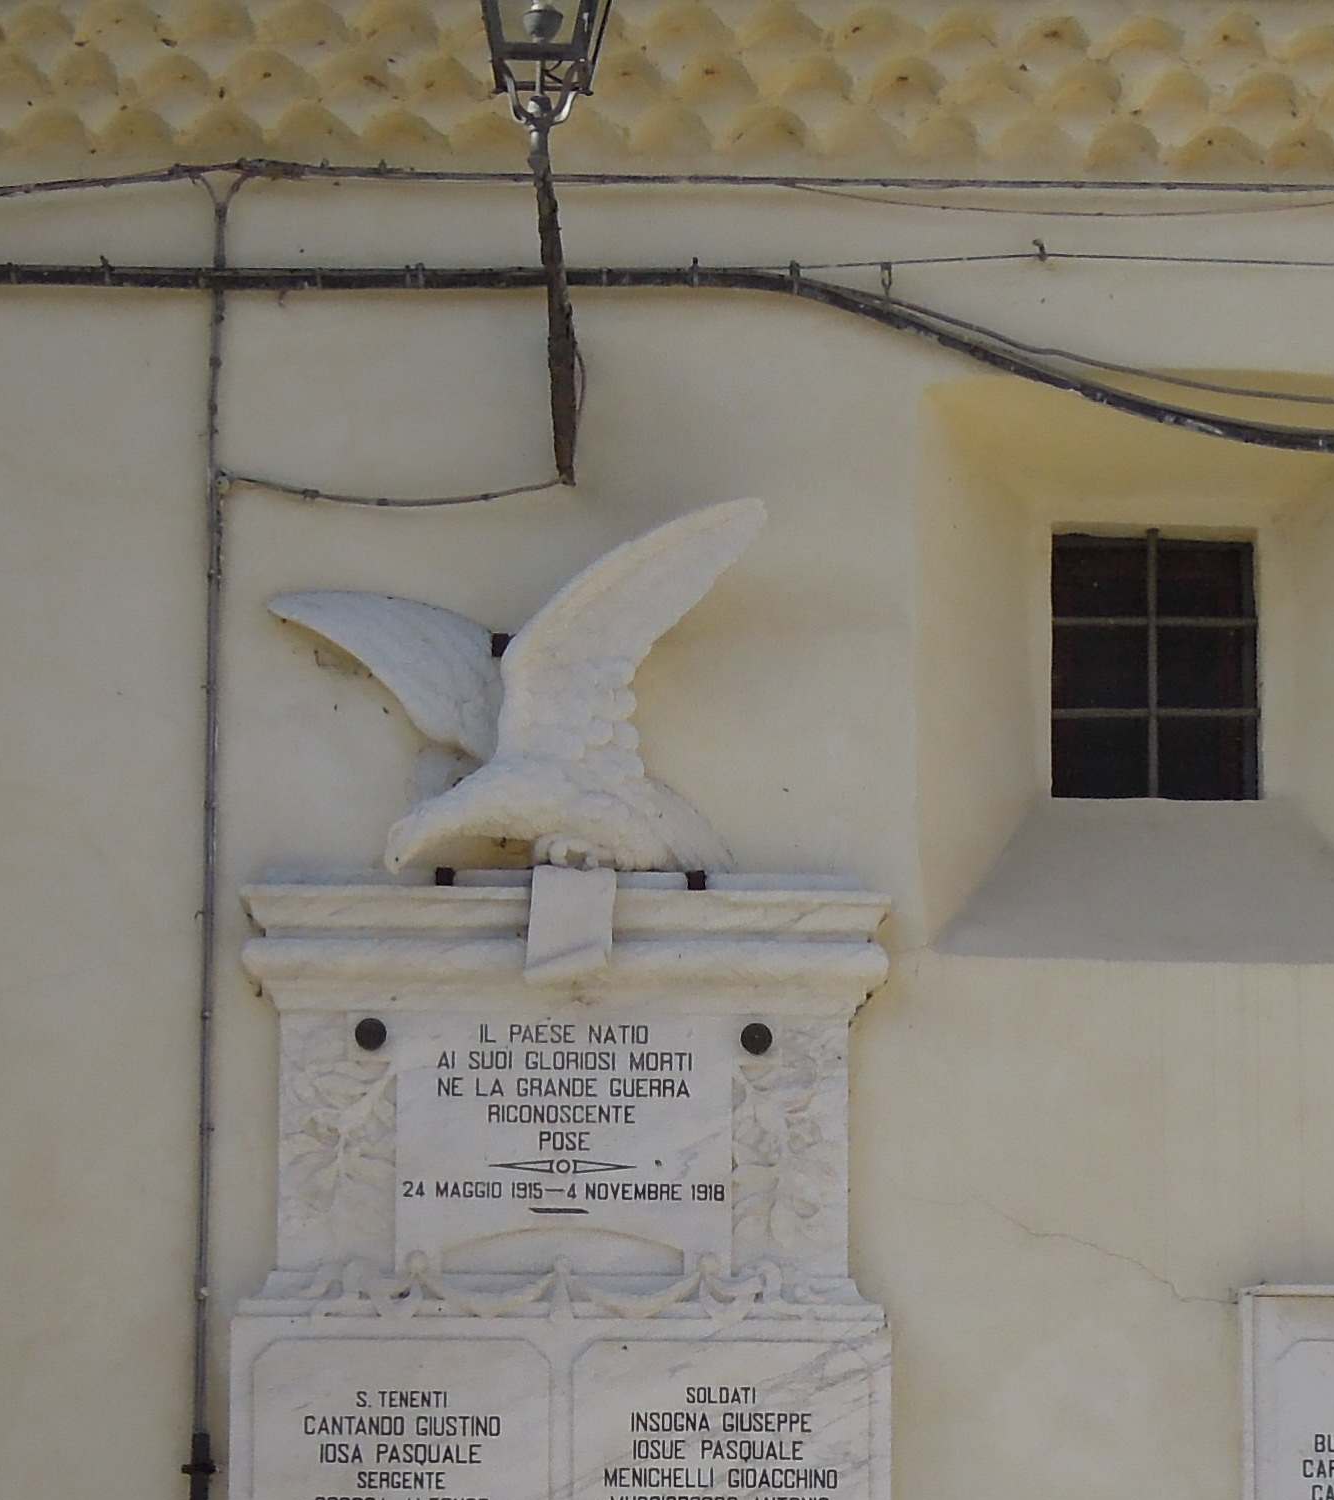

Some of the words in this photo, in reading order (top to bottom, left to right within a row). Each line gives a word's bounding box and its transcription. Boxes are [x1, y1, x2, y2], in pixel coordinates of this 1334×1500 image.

[479, 1023, 497, 1044] IL
[509, 1024, 576, 1045] PAESE
[588, 1024, 649, 1045] NATIO
[436, 1050, 456, 1070] AI
[468, 1050, 513, 1071] SUOI
[525, 1050, 616, 1072] GLORIOSI
[629, 1051, 693, 1072] MORTI
[437, 1076, 464, 1097] NE
[475, 1077, 505, 1098] LA
[516, 1077, 598, 1098] GRANDE
[609, 1077, 690, 1098] GUERRA
[488, 1103, 636, 1125] RICONOSCENTE
[538, 1130, 591, 1152] POSE
[402, 1180, 426, 1198] 24
[435, 1180, 502, 1199] MAGGIO
[585, 1182, 683, 1201] NOVEMBRE
[691, 1183, 725, 1202] 1918
[355, 1390, 372, 1408] S.
[377, 1390, 448, 1409] TENENTI
[686, 1386, 756, 1405] SOLDATI
[304, 1415, 405, 1437] CANTANDO
[415, 1415, 501, 1437] GIUSTINO
[631, 1411, 711, 1433] INSOGNA
[722, 1411, 812, 1434] GIUSEPPE
[319, 1442, 363, 1464] IOSA
[376, 1443, 482, 1467] PASQUALE
[632, 1439, 686, 1461] IOSUE
[700, 1439, 804, 1464] PASQUALE
[357, 1471, 446, 1490] SERGENTE
[604, 1467, 714, 1489] MENICHELLI
[727, 1467, 838, 1490] GIOACCHINO
